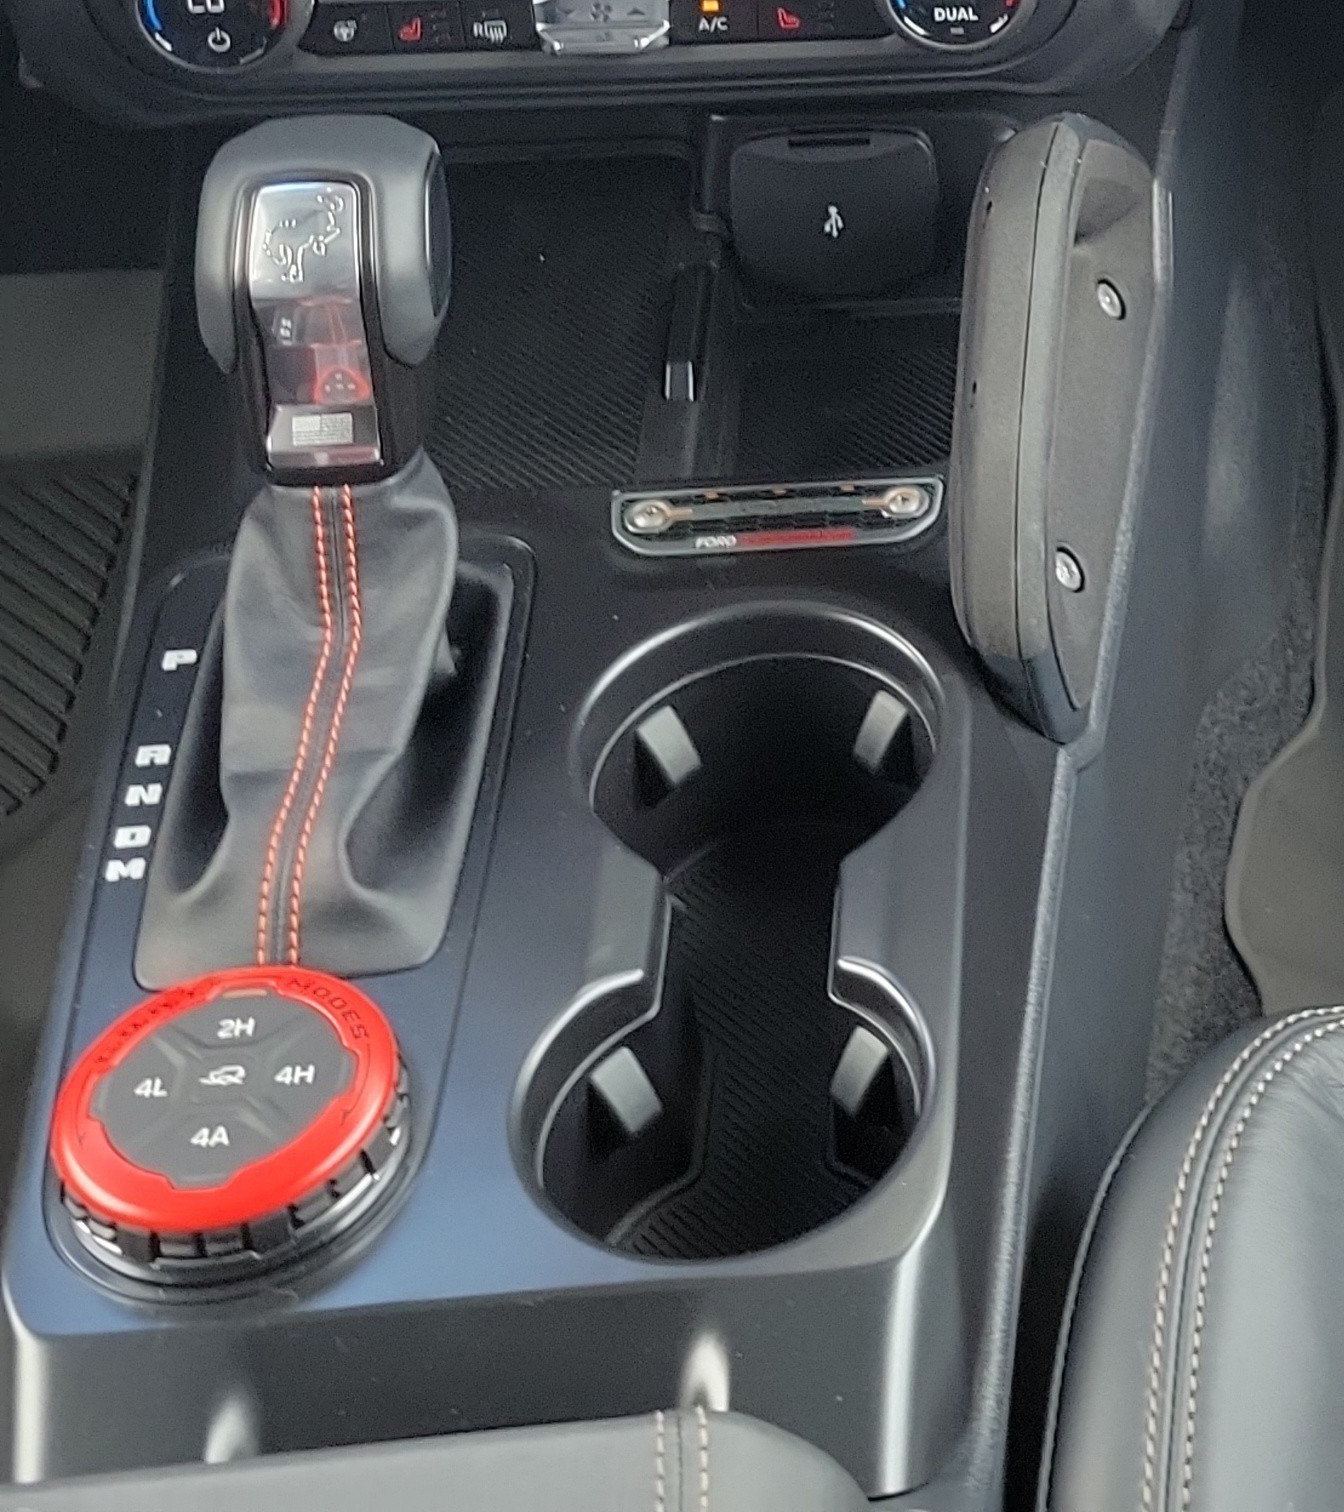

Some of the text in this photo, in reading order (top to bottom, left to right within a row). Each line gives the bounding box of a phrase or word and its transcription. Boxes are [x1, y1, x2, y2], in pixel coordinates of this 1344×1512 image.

[699, 16, 728, 32] A/C
[934, 6, 979, 24] DUAL
[161, 648, 198, 671] P
[135, 743, 172, 768] R
[125, 782, 163, 807] N
[113, 825, 152, 849] D
[105, 858, 145, 882] M
[217, 1017, 256, 1039] 2H
[274, 1064, 316, 1085] 4H
[133, 1077, 168, 1099] 4L
[190, 1125, 230, 1148] 4A
